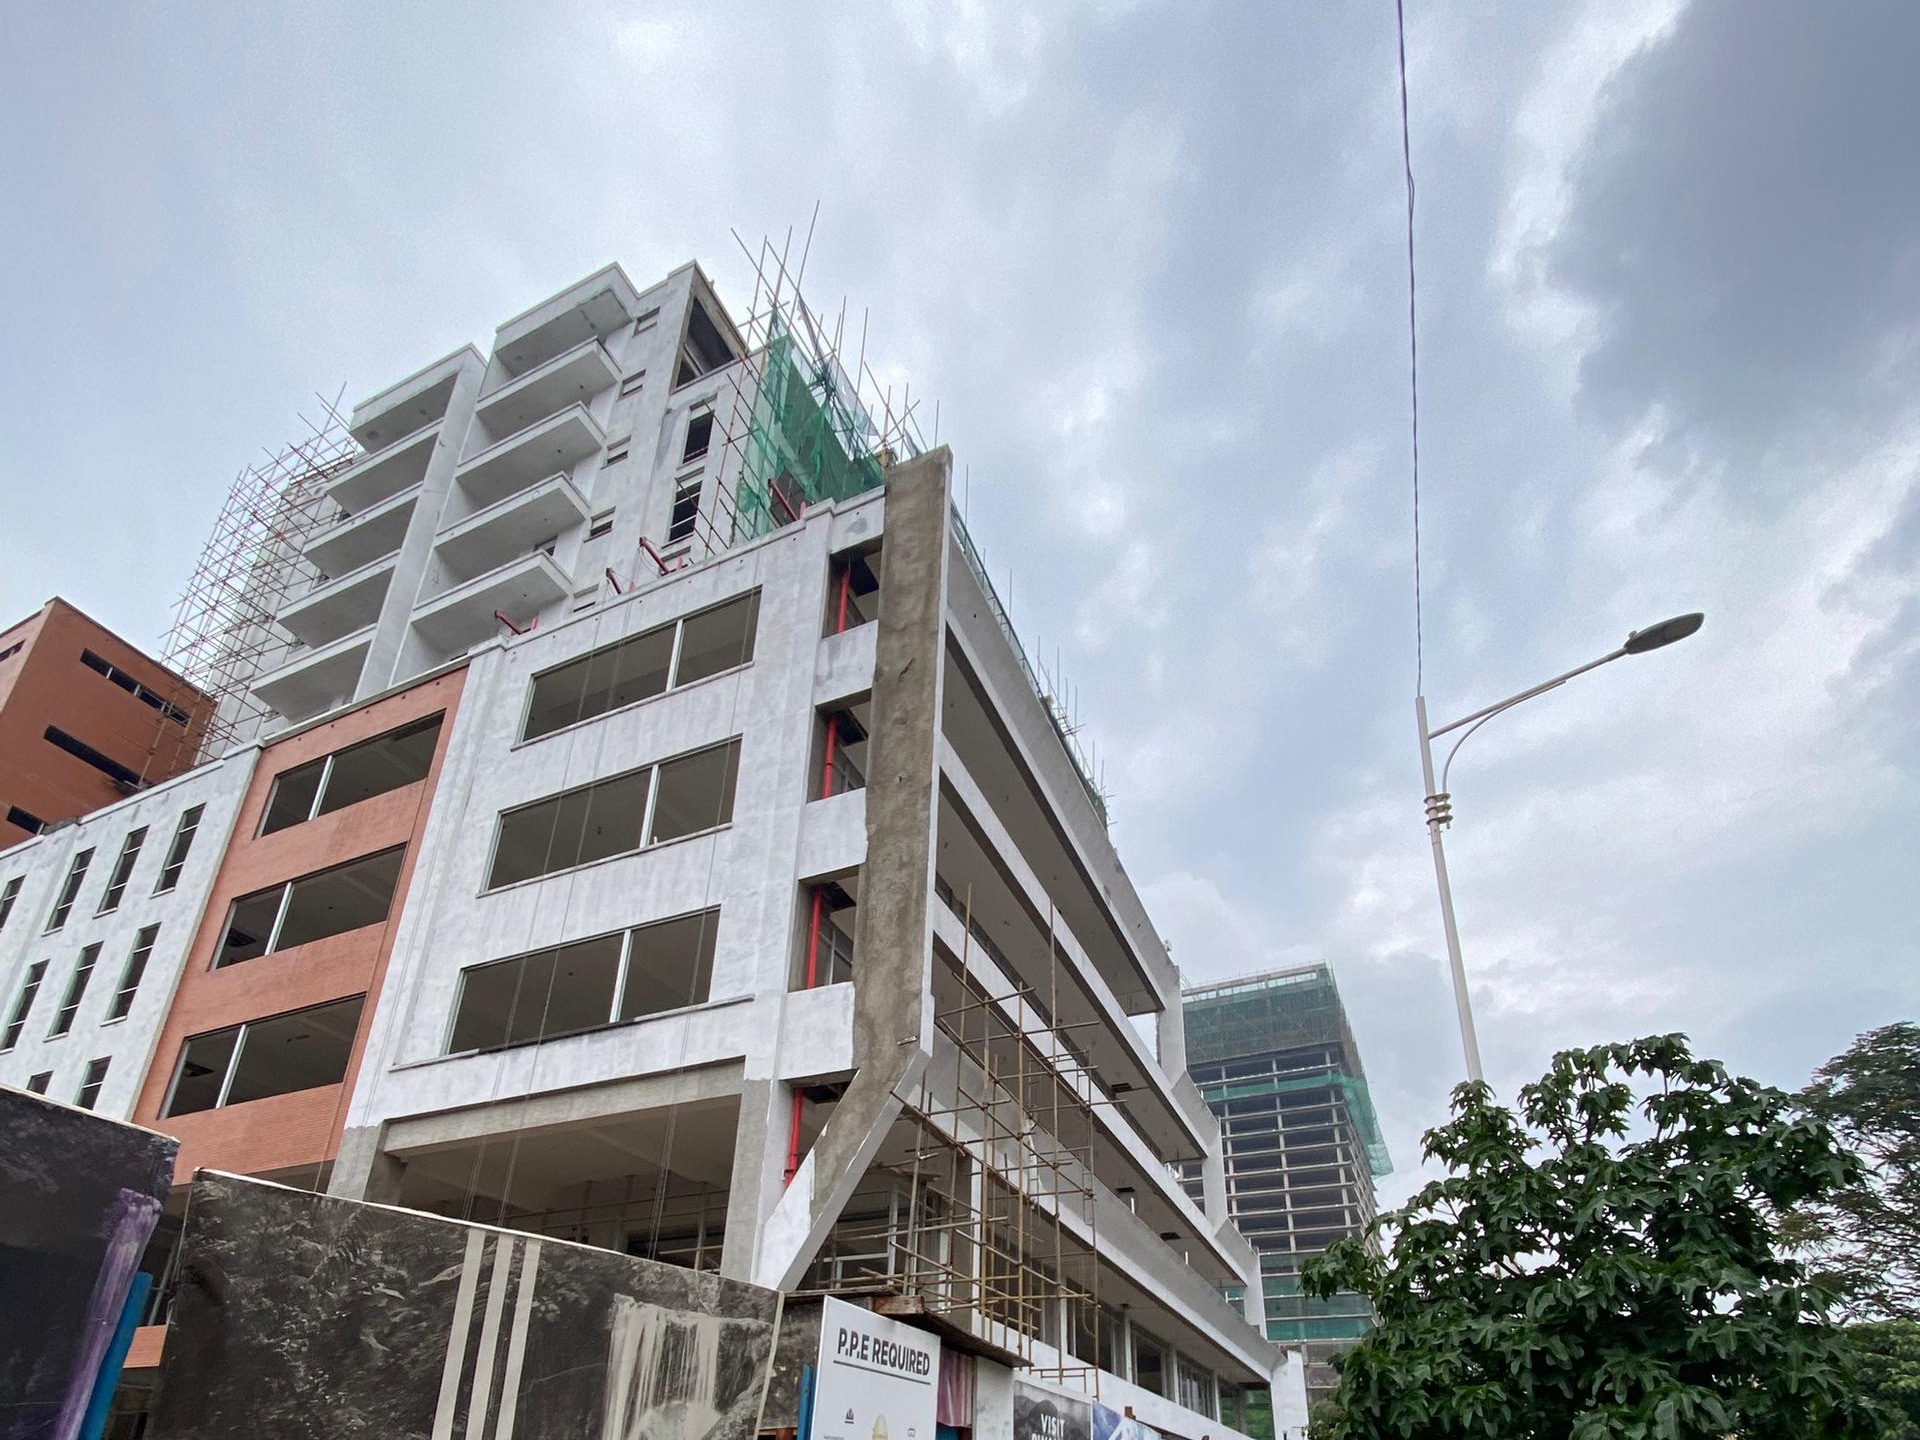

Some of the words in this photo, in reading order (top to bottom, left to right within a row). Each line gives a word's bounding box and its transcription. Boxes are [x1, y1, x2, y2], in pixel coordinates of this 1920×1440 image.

[837, 1327, 870, 1361] P.P.E
[871, 1337, 930, 1375] REQUIRED
[1040, 1413, 1065, 1438] VISIT
